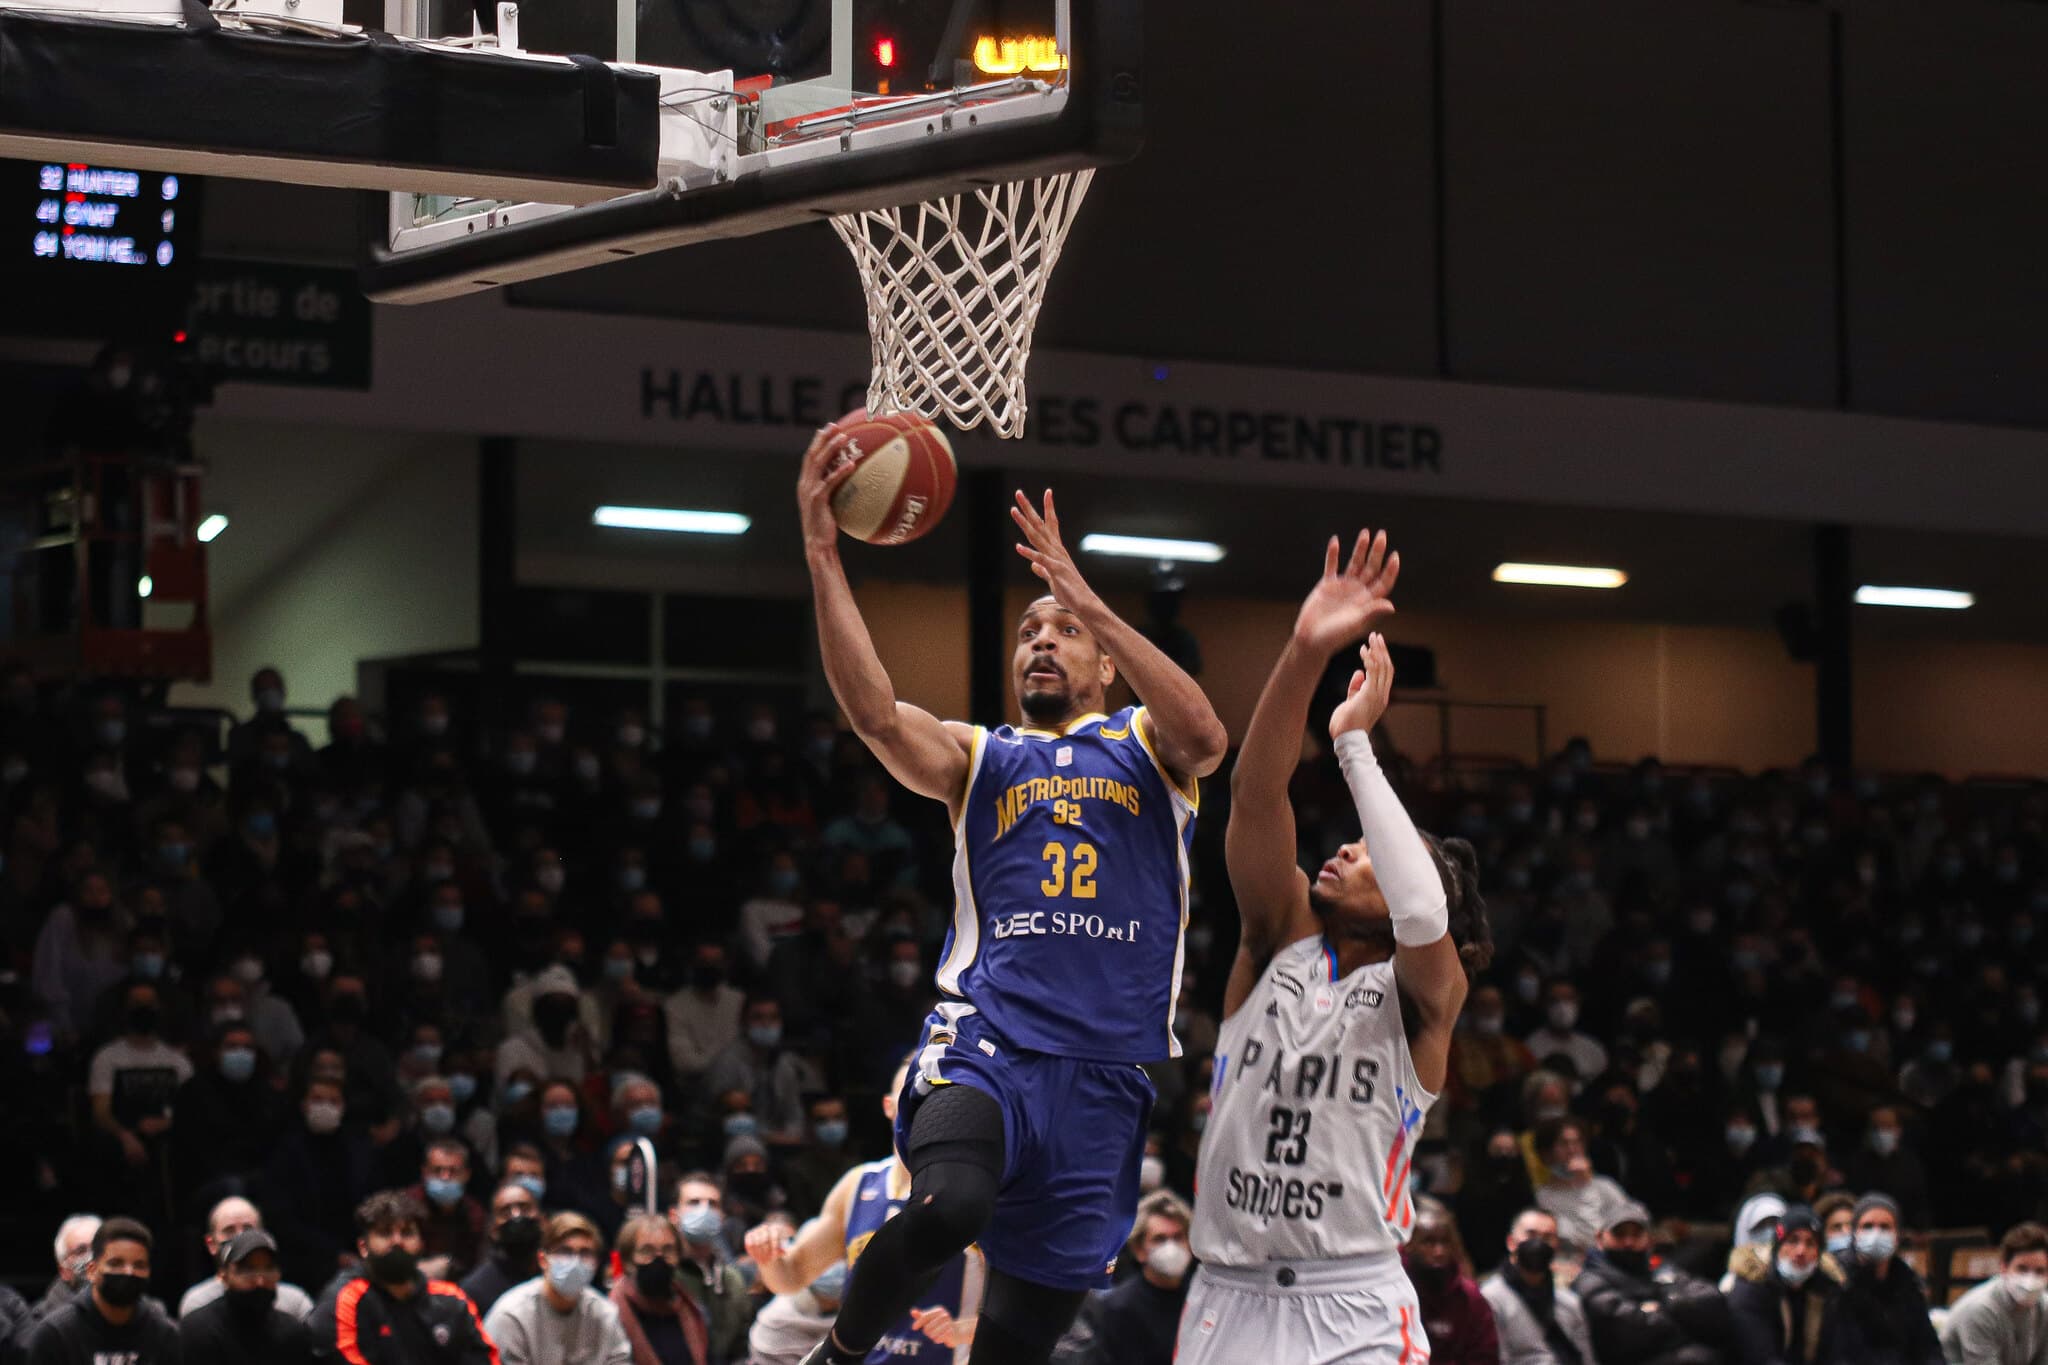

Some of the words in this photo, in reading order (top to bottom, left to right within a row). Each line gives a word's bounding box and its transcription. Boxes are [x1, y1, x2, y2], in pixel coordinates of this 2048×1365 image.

[294, 283, 340, 323] de
[192, 333, 331, 374] ecours
[640, 368, 822, 425] HALLE
[1113, 401, 1444, 473] CARPENTIER
[993, 774, 1140, 842] METROPOLITANS
[1053, 799, 1083, 826] 92
[1041, 842, 1098, 898] 32
[1236, 1037, 1380, 1104] PARIS
[1265, 1106, 1312, 1166] 23
